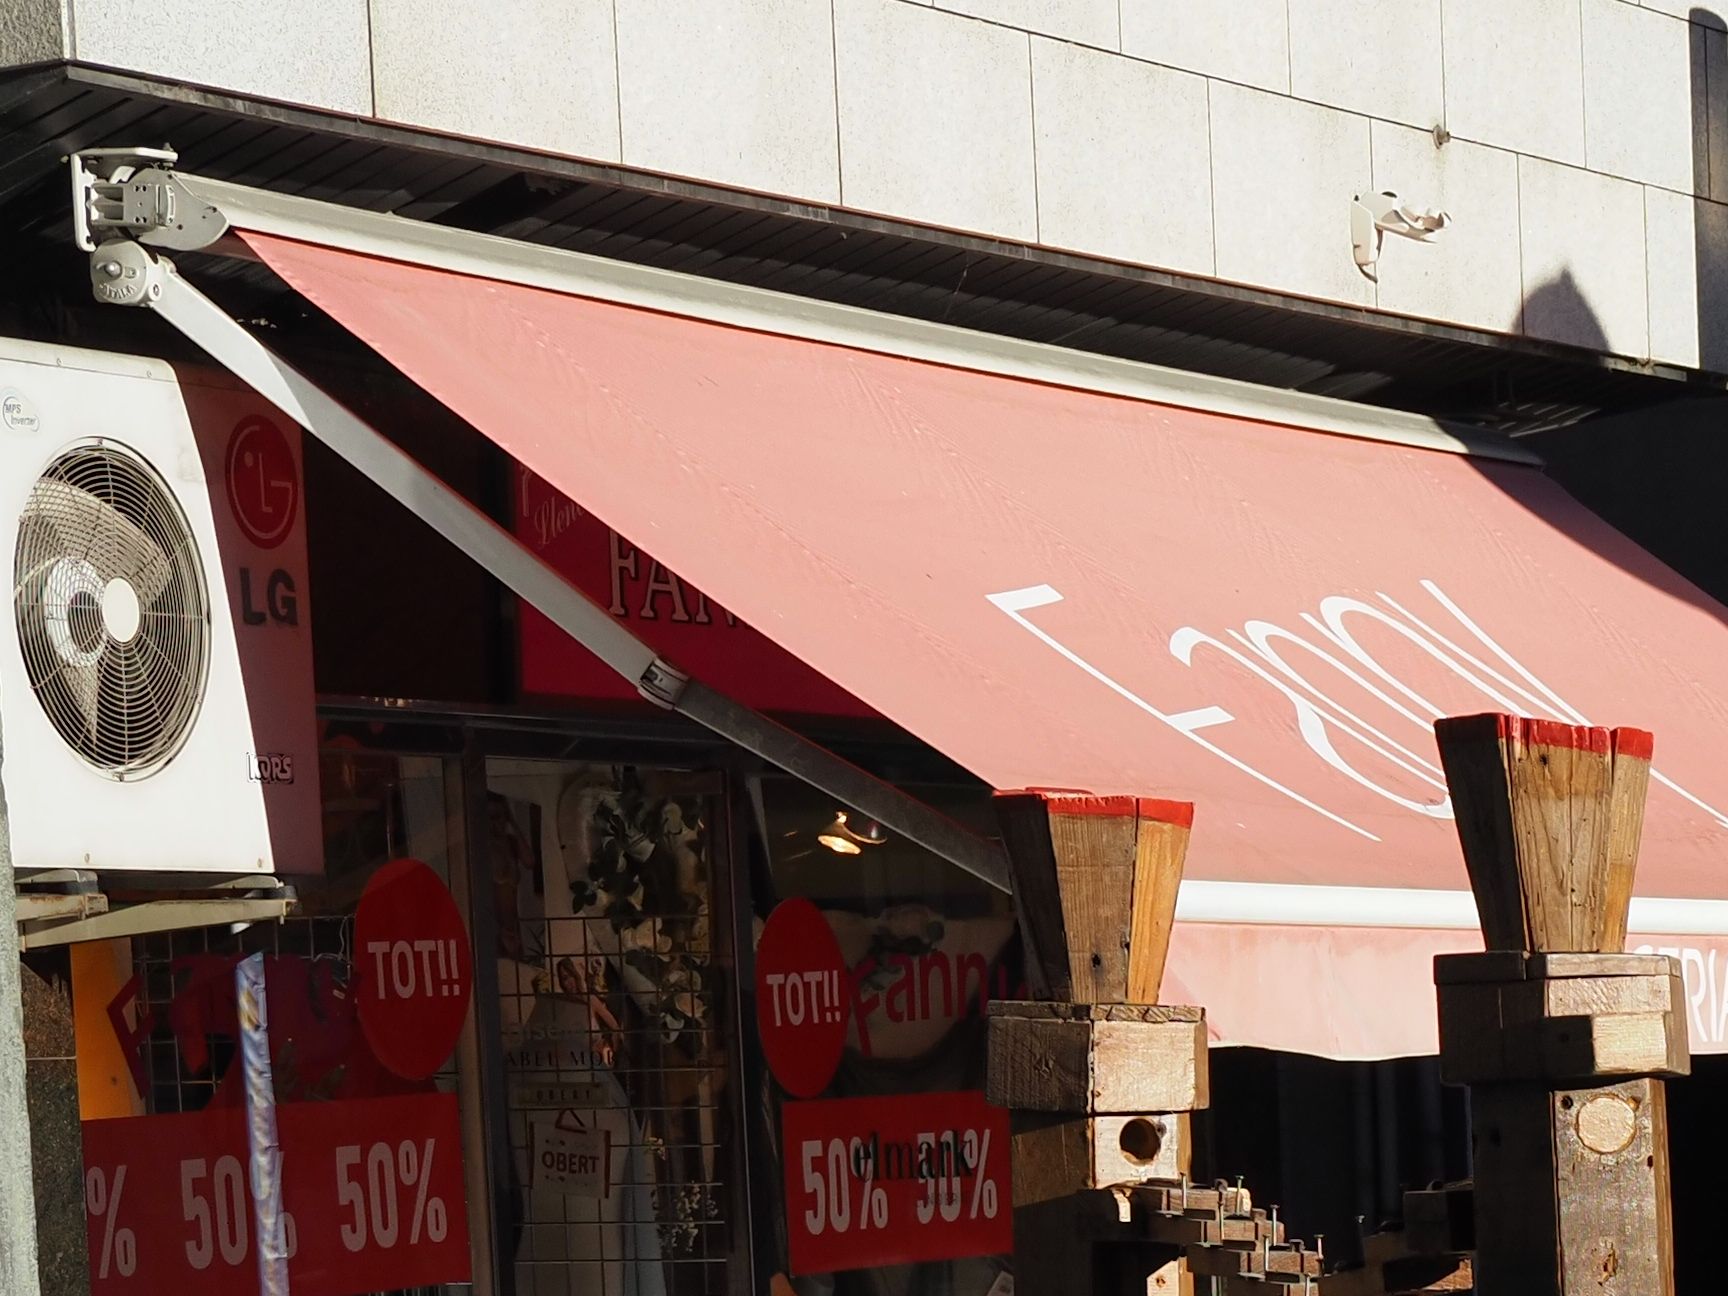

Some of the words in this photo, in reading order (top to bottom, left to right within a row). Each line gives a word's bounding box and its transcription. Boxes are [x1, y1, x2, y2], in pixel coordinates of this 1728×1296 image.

[239, 567, 298, 626] LG
[367, 938, 460, 1001] TOT!!
[765, 968, 842, 1028] TOT!!
[541, 1151, 600, 1175] OBERT
[335, 1137, 448, 1253] 50%
